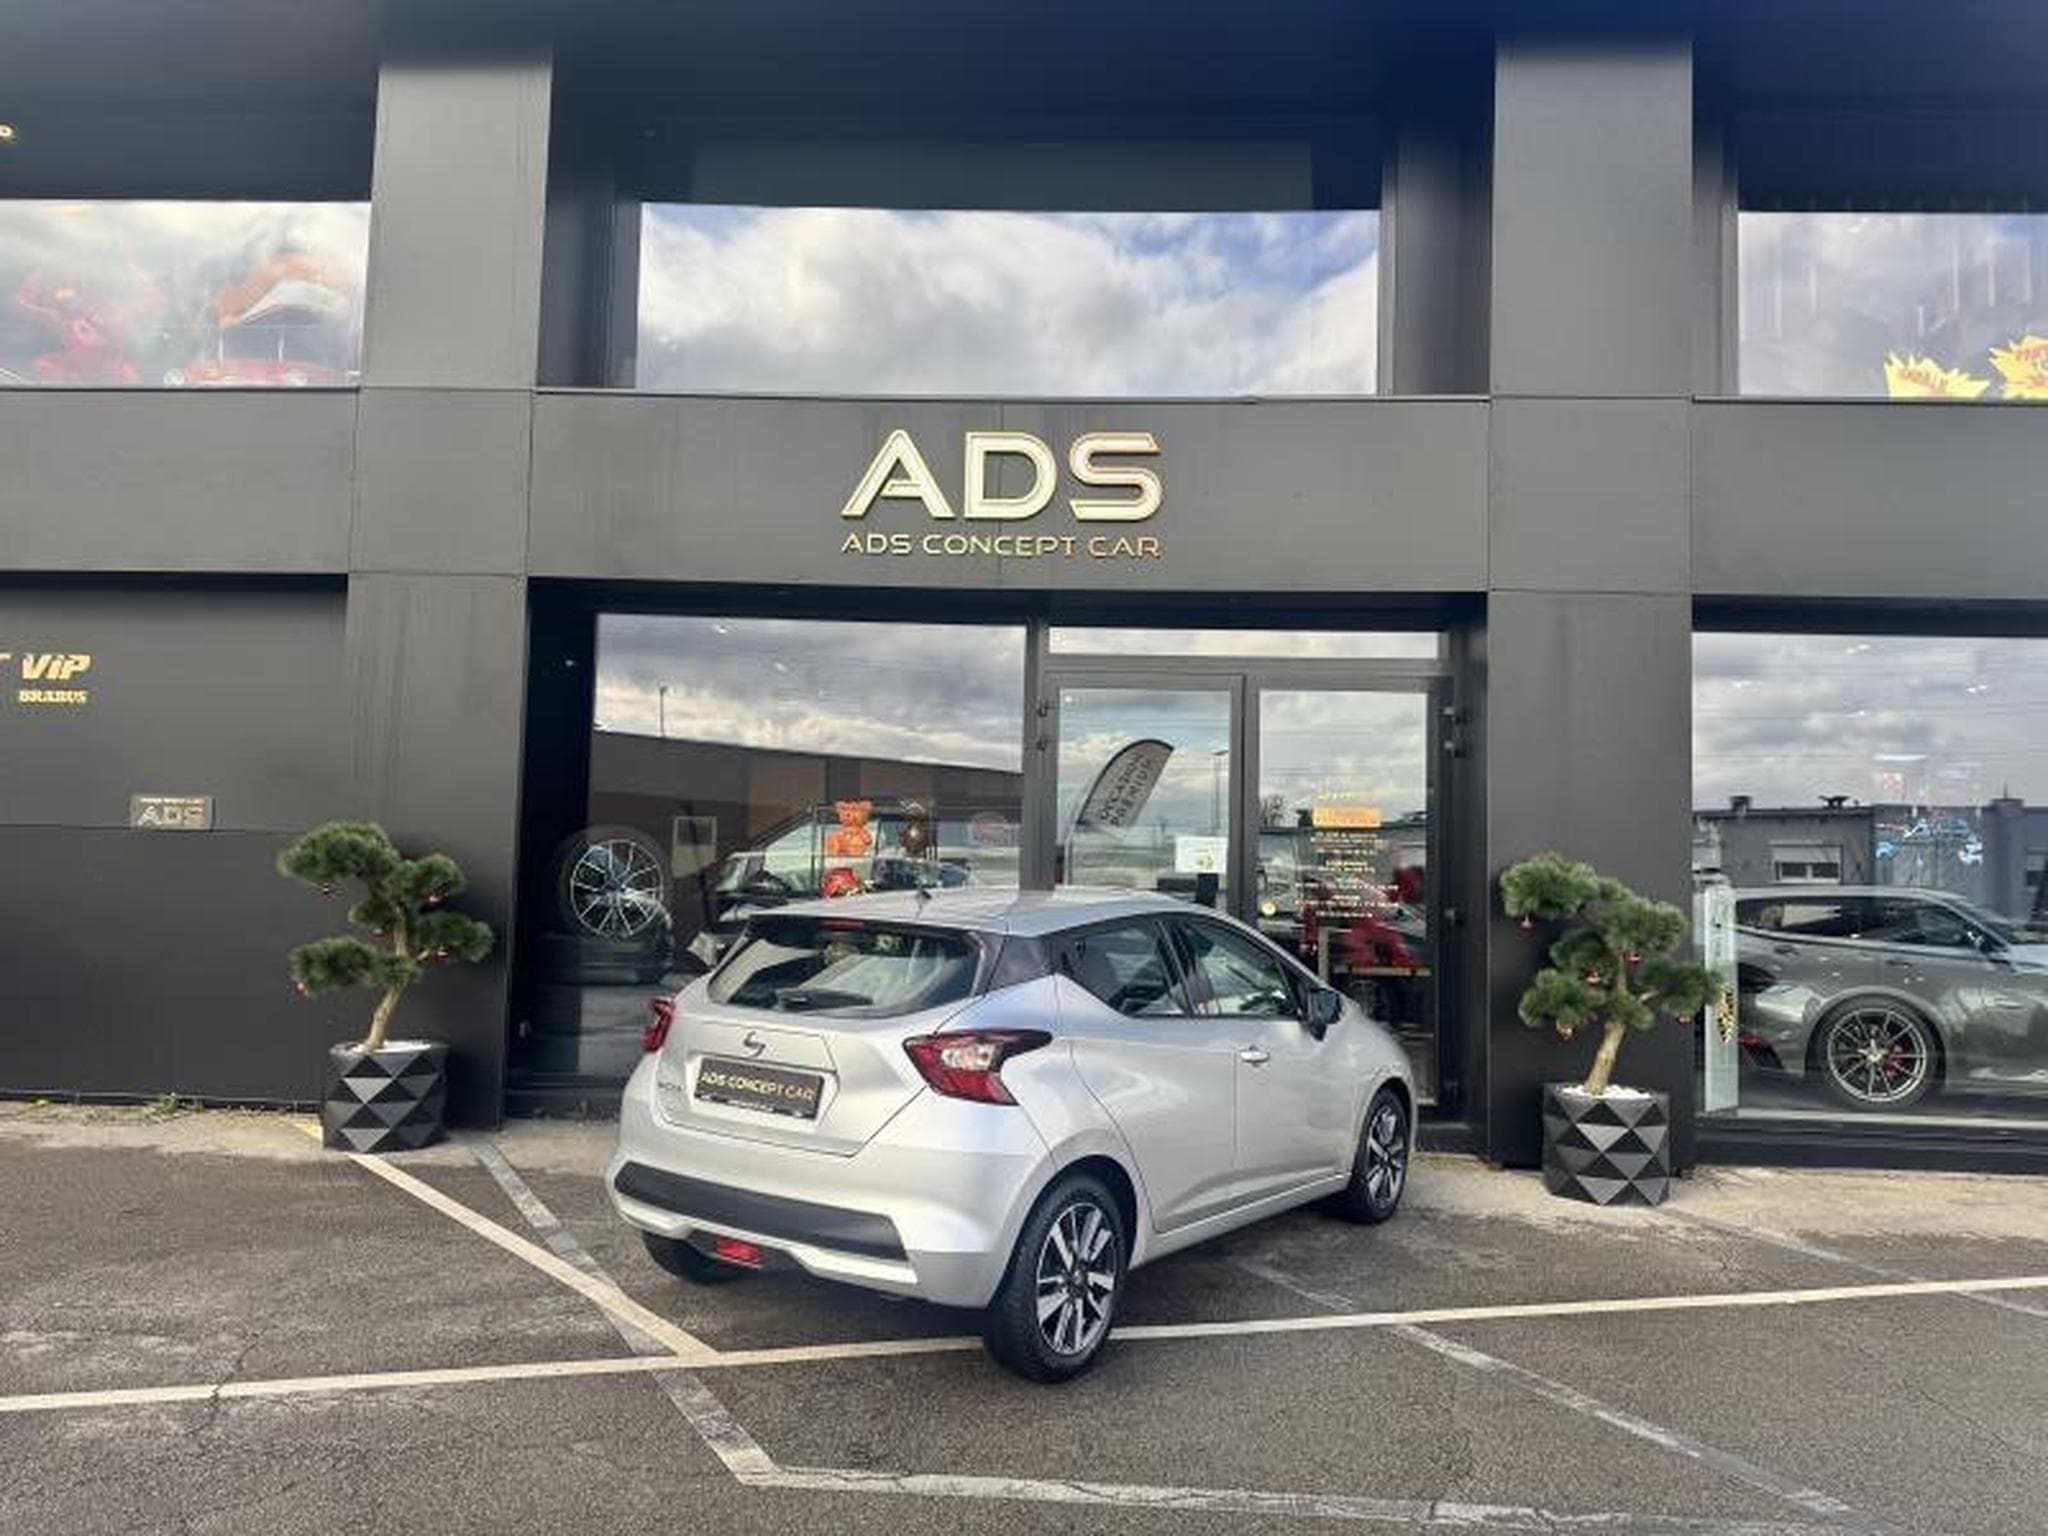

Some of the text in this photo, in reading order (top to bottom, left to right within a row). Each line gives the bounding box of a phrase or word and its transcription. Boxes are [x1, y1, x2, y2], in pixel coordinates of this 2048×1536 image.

[841, 429, 1163, 521] ADS
[841, 533, 1160, 559] ADS CONCEPT CAR
[700, 1071, 726, 1087] ADS
[727, 1075, 783, 1096] CONCEPT
